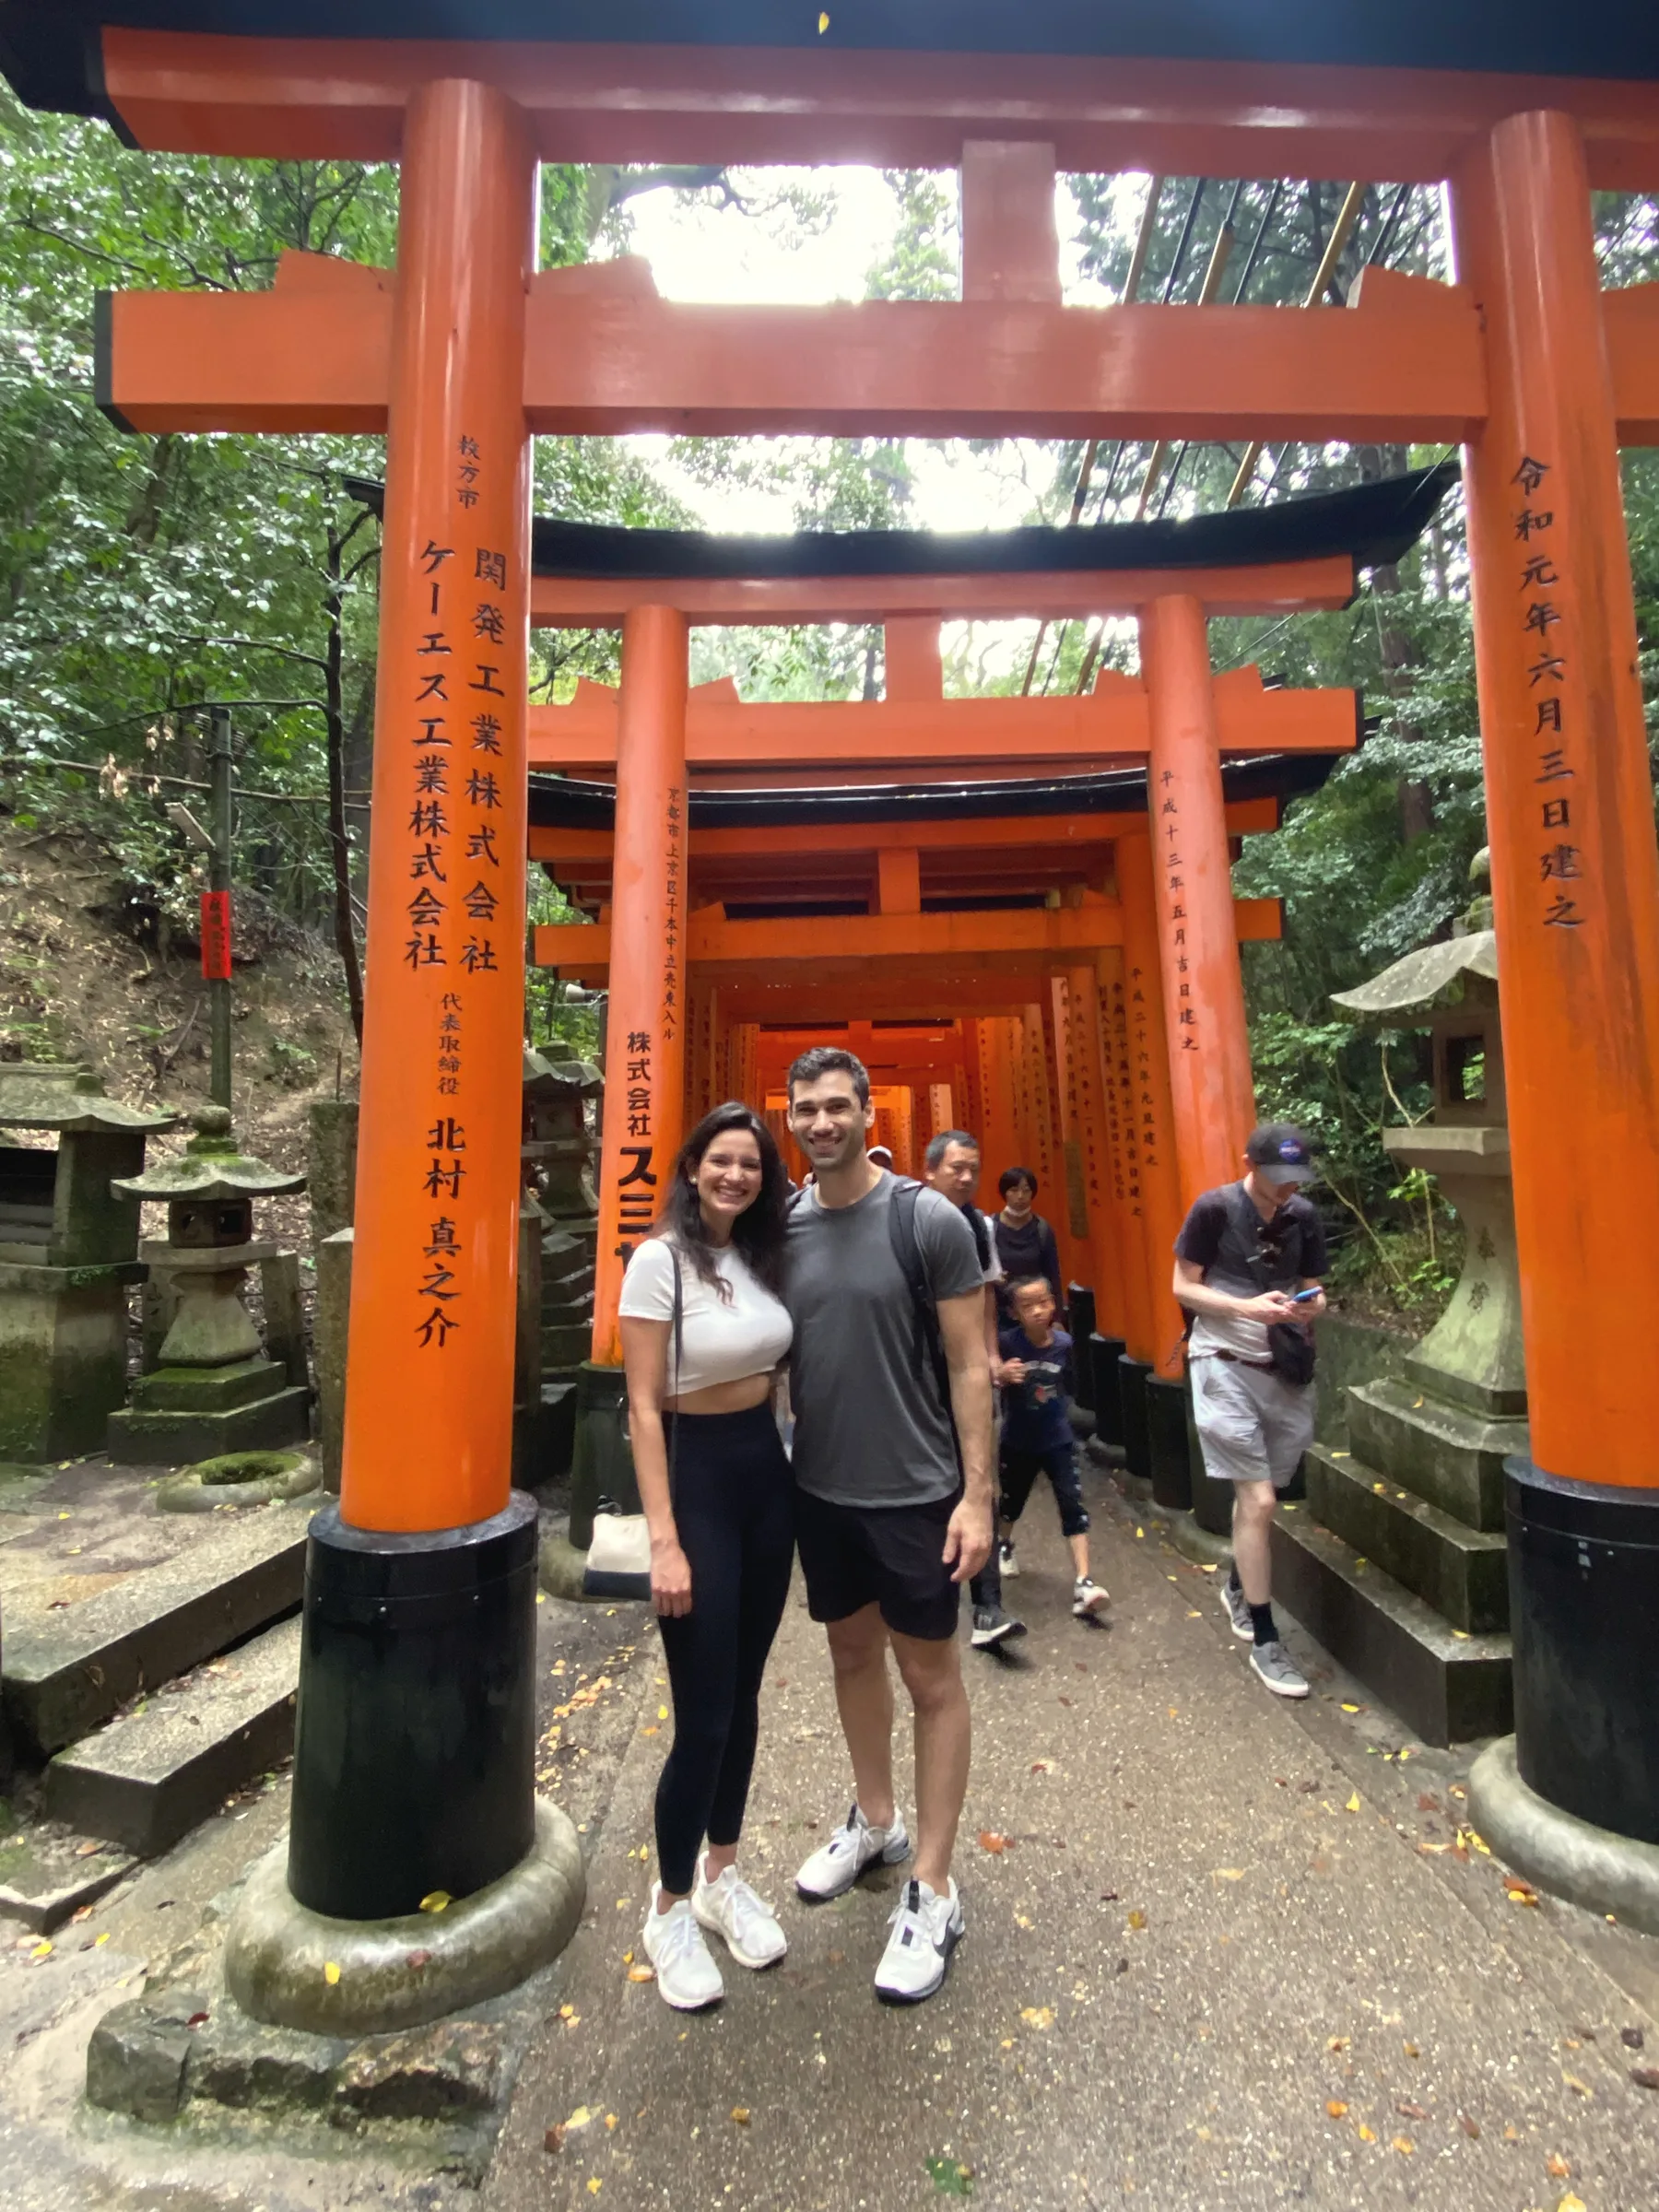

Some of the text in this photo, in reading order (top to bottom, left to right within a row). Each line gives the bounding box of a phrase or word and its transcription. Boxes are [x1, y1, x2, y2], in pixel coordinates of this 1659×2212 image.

[456, 434, 480, 510] 枚方市
[404, 539, 455, 971] ケーエス工業株式会社
[459, 547, 507, 974] 関発工業株式会社
[1510, 456, 1585, 928] 令和元年六月三日建之
[1160, 771, 1198, 1051] 平成十三年五月吉日建之
[414, 993, 467, 1348] 代表取締役 北村 真之介
